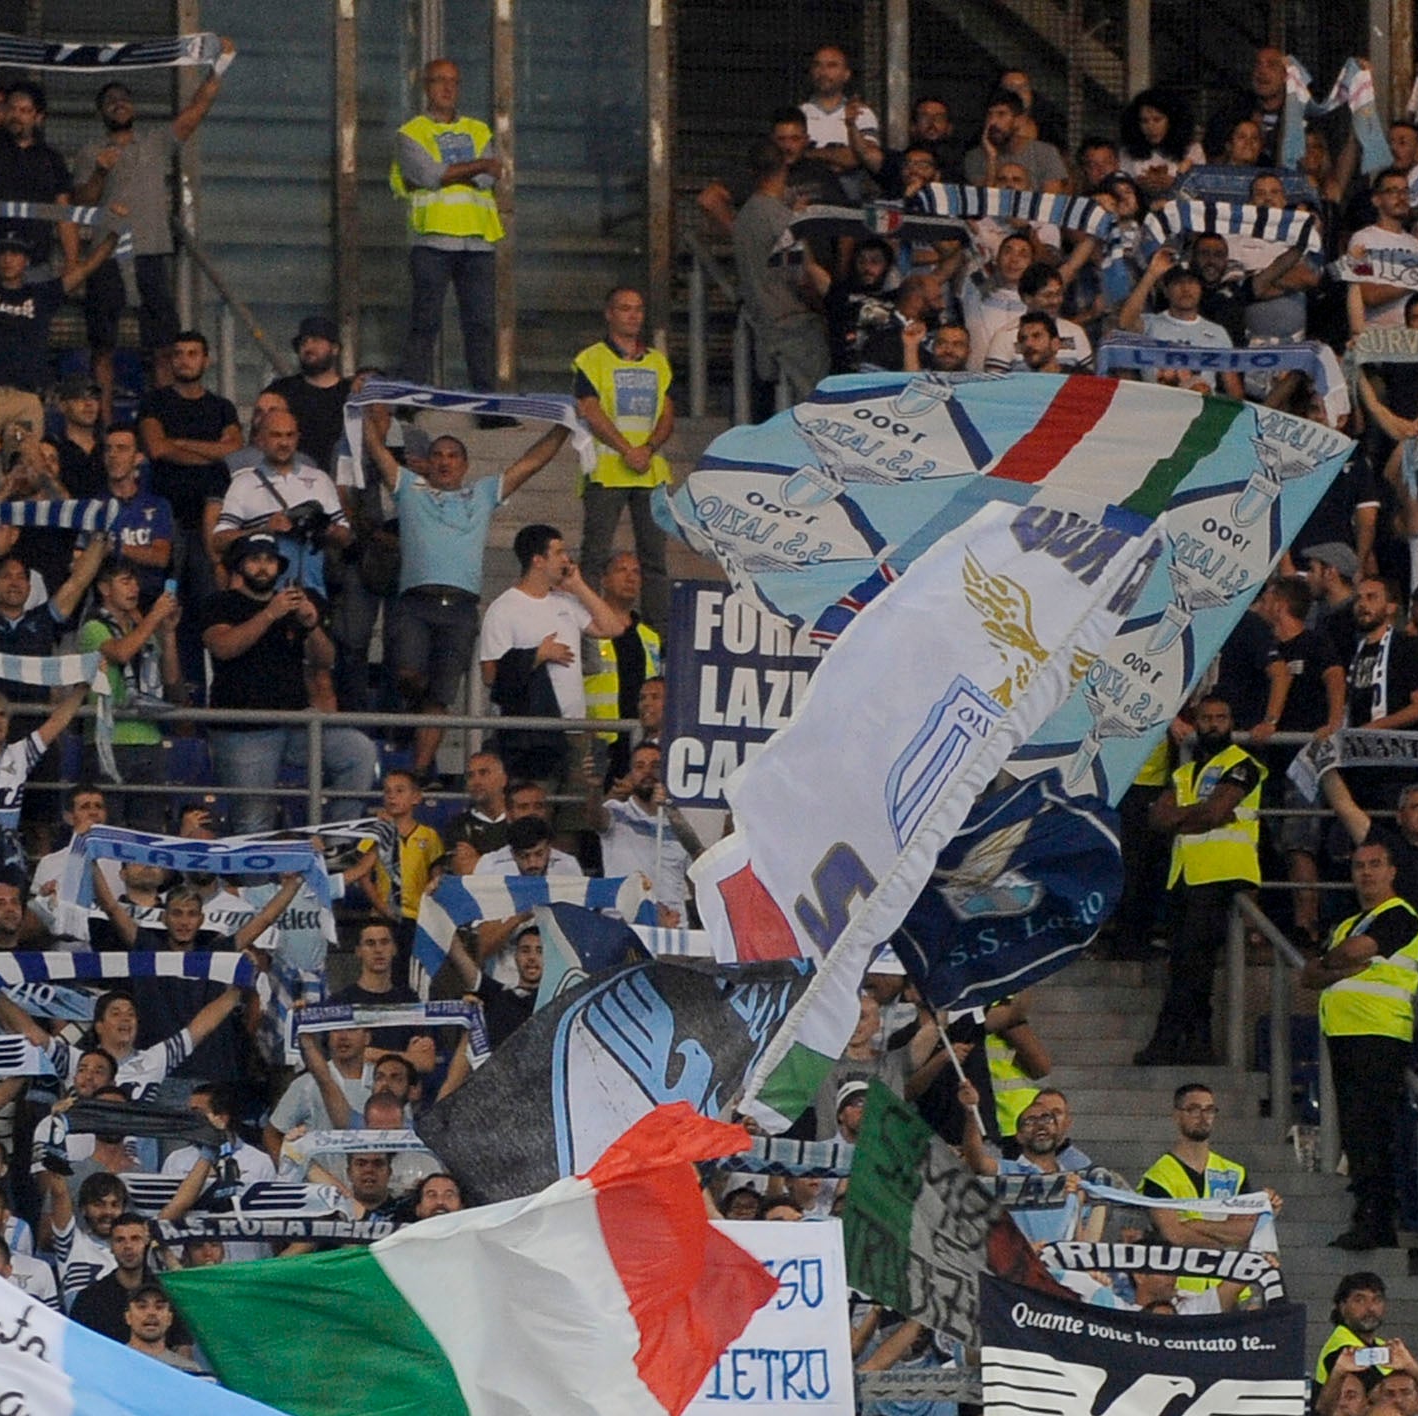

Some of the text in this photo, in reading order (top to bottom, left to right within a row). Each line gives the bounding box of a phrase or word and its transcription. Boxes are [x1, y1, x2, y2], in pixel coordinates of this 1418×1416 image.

[1132, 349, 1281, 368] LAZIO
[112, 842, 277, 871] LAZIO
[1010, 1302, 1277, 1351] Quante volte ho cantato te...
